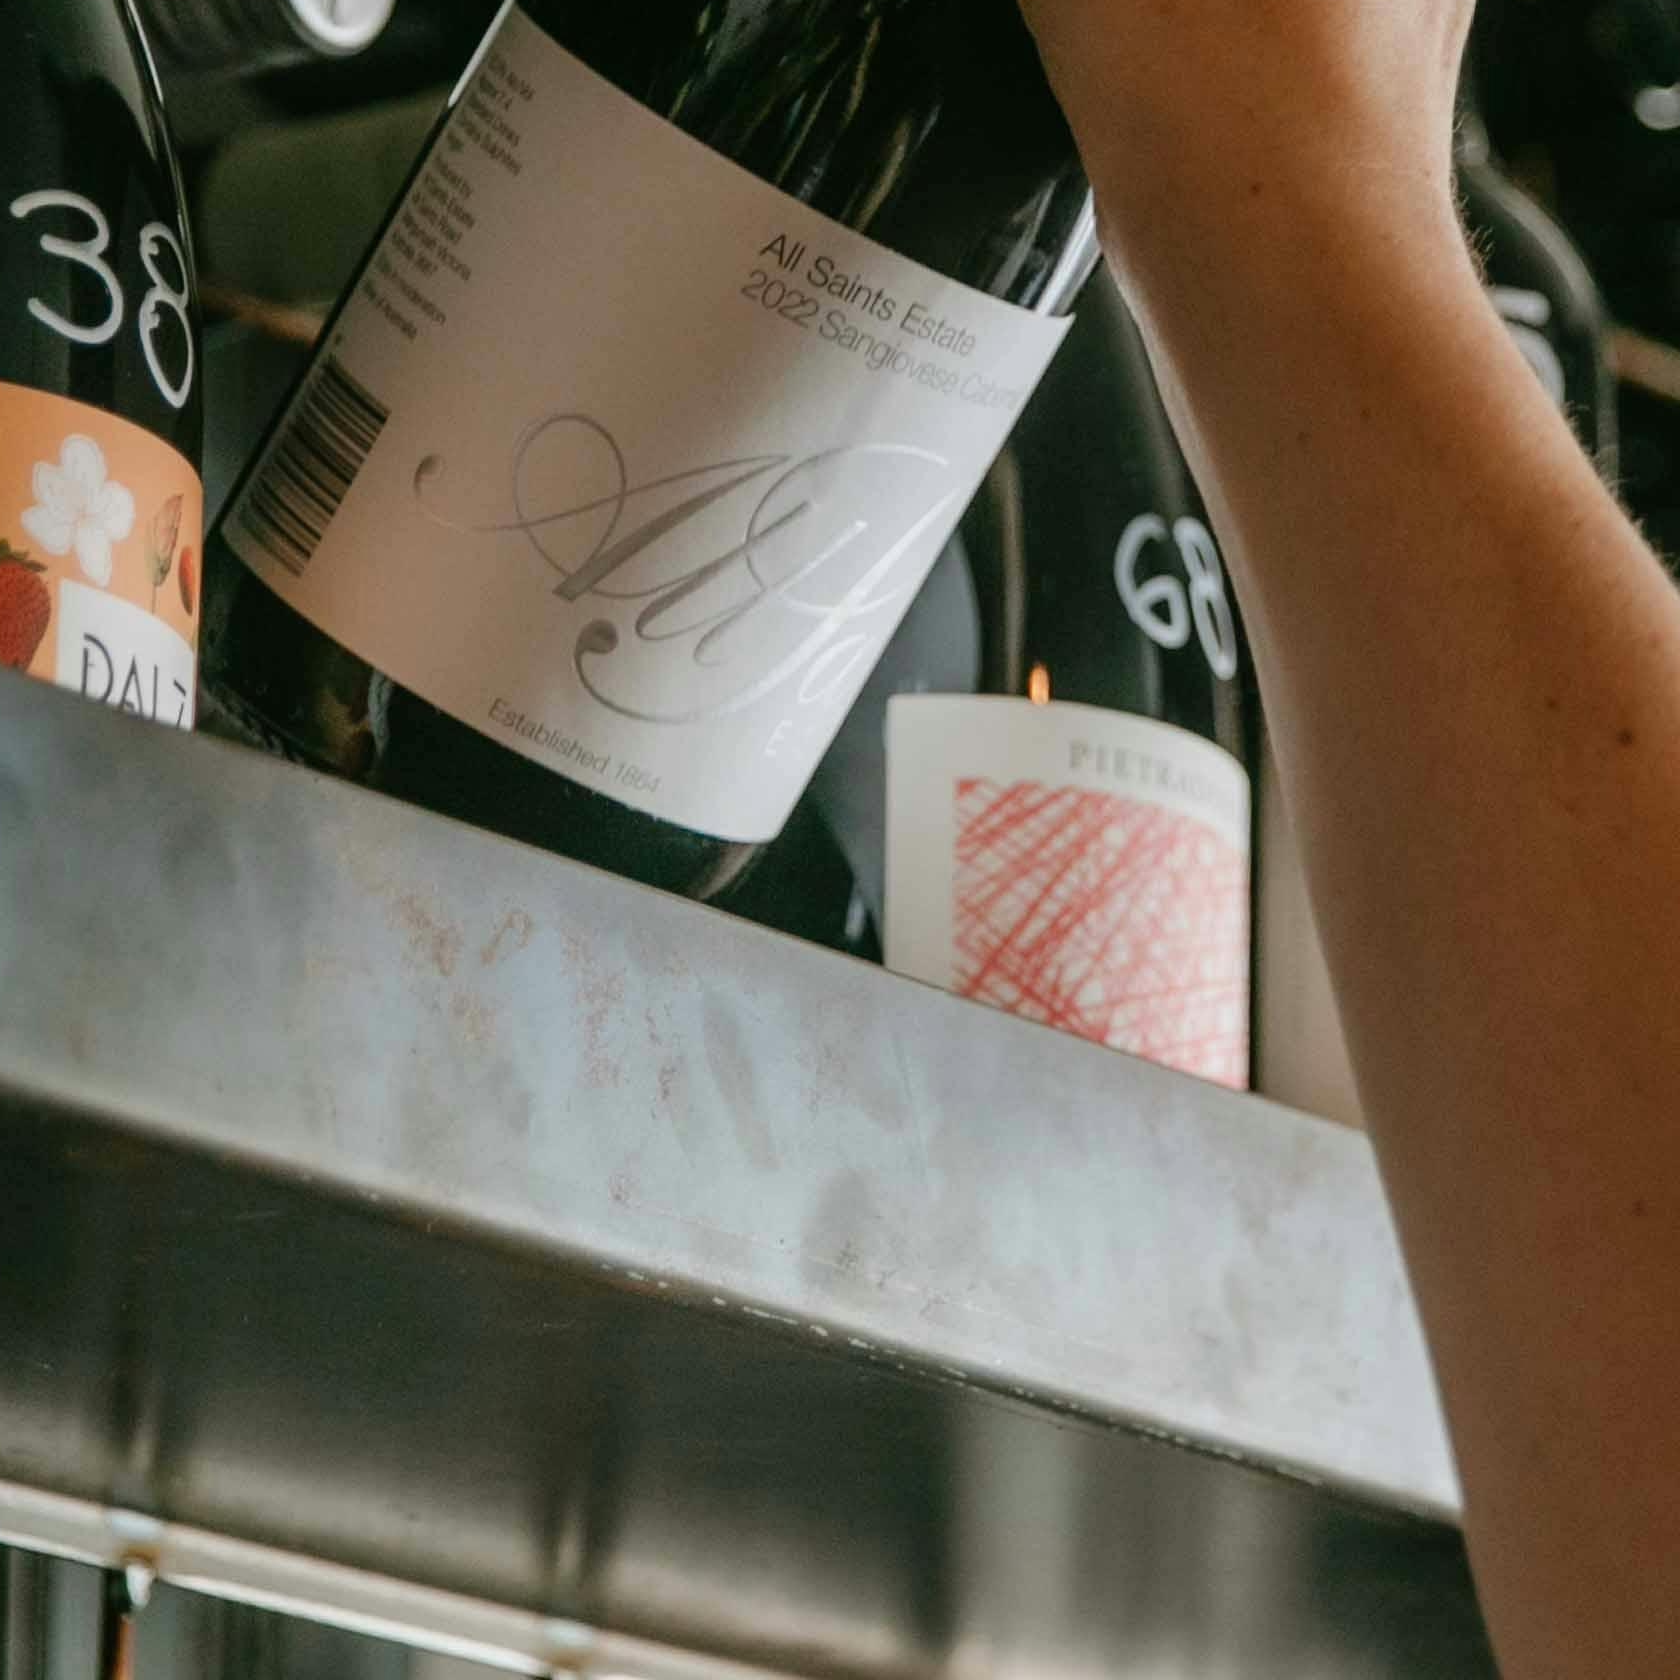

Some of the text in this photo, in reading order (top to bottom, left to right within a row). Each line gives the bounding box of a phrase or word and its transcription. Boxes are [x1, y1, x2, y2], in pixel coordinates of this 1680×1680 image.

[8, 188, 195, 409] 38
[740, 268, 819, 329] 2022
[819, 308, 960, 396] Sangiovese
[759, 232, 977, 357] All Saints Estate
[1114, 511, 1238, 682] 68
[488, 696, 611, 777] Established
